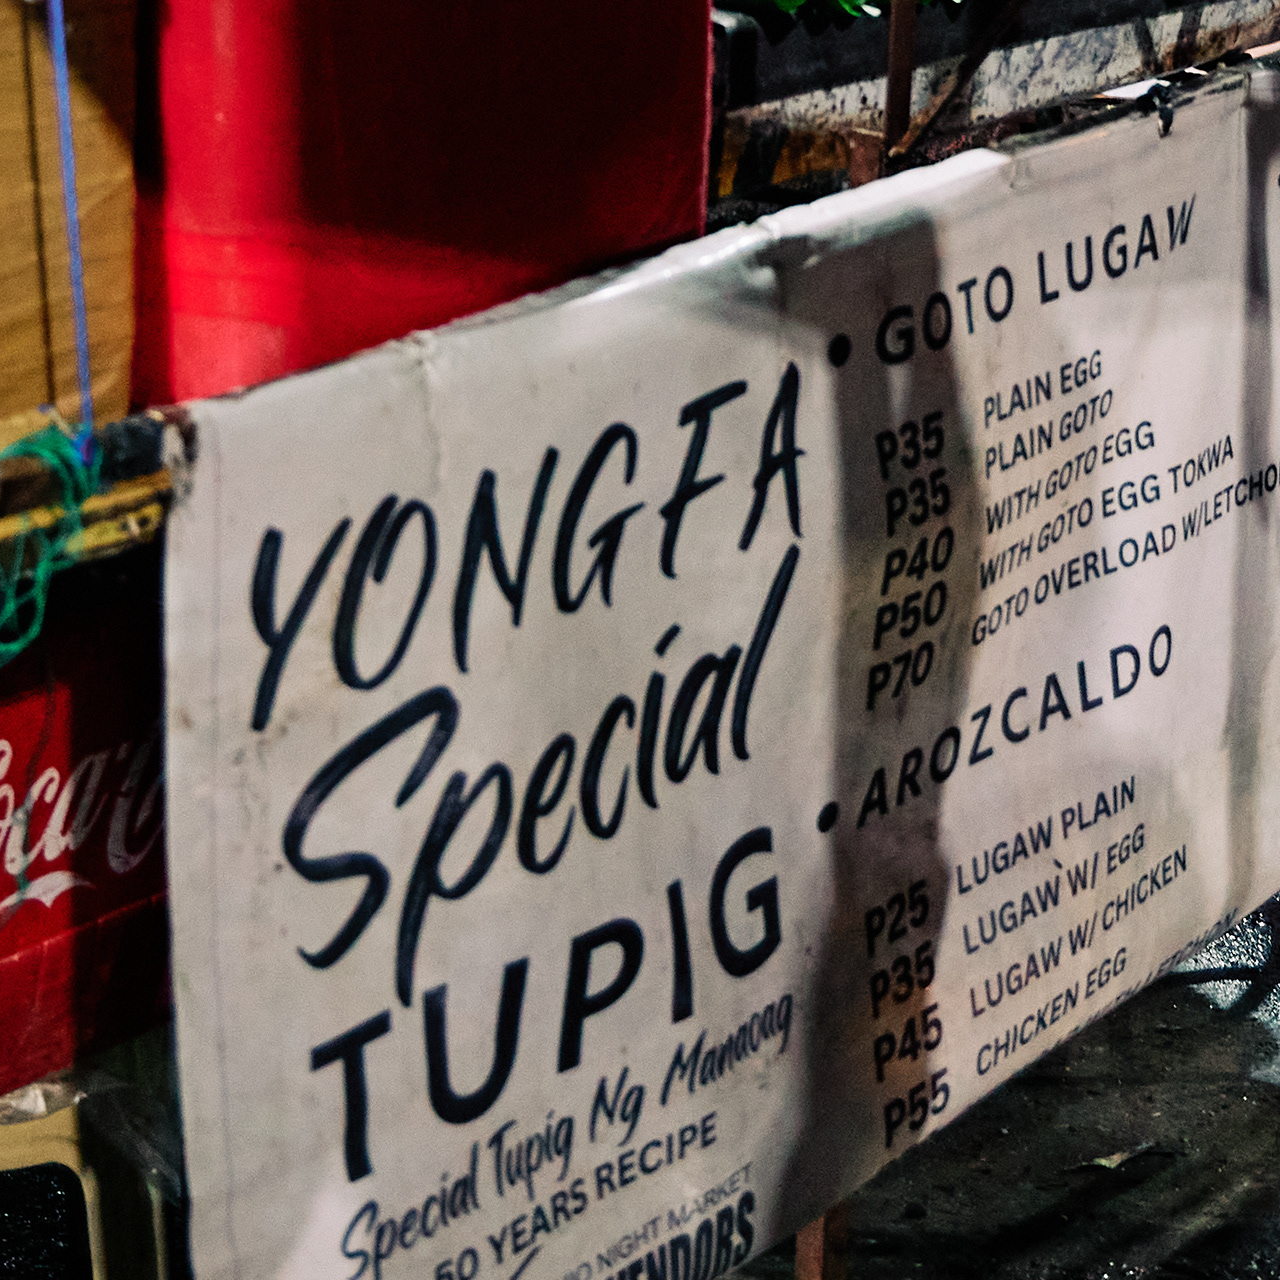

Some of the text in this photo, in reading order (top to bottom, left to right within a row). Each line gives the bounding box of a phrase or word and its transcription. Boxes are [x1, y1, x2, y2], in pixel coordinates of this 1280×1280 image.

[874, 193, 1197, 366] GOTO LUGAW
[873, 388, 1114, 482] P35 PLAIN GOTO
[885, 420, 1156, 539] P35 WITH GOTO EGG
[982, 348, 1104, 429] PLAIN EGG
[249, 360, 805, 733] YONGFA
[872, 580, 948, 651] P50
[970, 586, 1030, 647] GOTO
[1033, 523, 1177, 605] OVERLOAD
[880, 434, 1234, 598] P40 WITH GOTO EGG TOKWA
[856, 623, 1174, 830] AROZCALDO
[865, 641, 934, 713] P70
[282, 542, 801, 1008] Special
[864, 775, 1137, 959] P25 LUGAW PLAIN
[309, 825, 783, 1183] TUPIG
[870, 823, 1146, 1020] P35 LUGAW W/ EGG
[872, 1005, 944, 1084] P45
[969, 935, 1064, 1019] LUGAW
[1068, 910, 1099, 959] W/
[1102, 844, 1190, 933] CHICKEN
[882, 1067, 952, 1150] P55
[975, 981, 1080, 1077] CHICKEN
[1084, 947, 1128, 1003] EGG
[340, 1141, 482, 1280] Special
[488, 1109, 575, 1202] Tupig
[588, 1066, 647, 1147] Ng
[487, 1178, 590, 1266] YEARS
[592, 1109, 720, 1201] RECIPE
